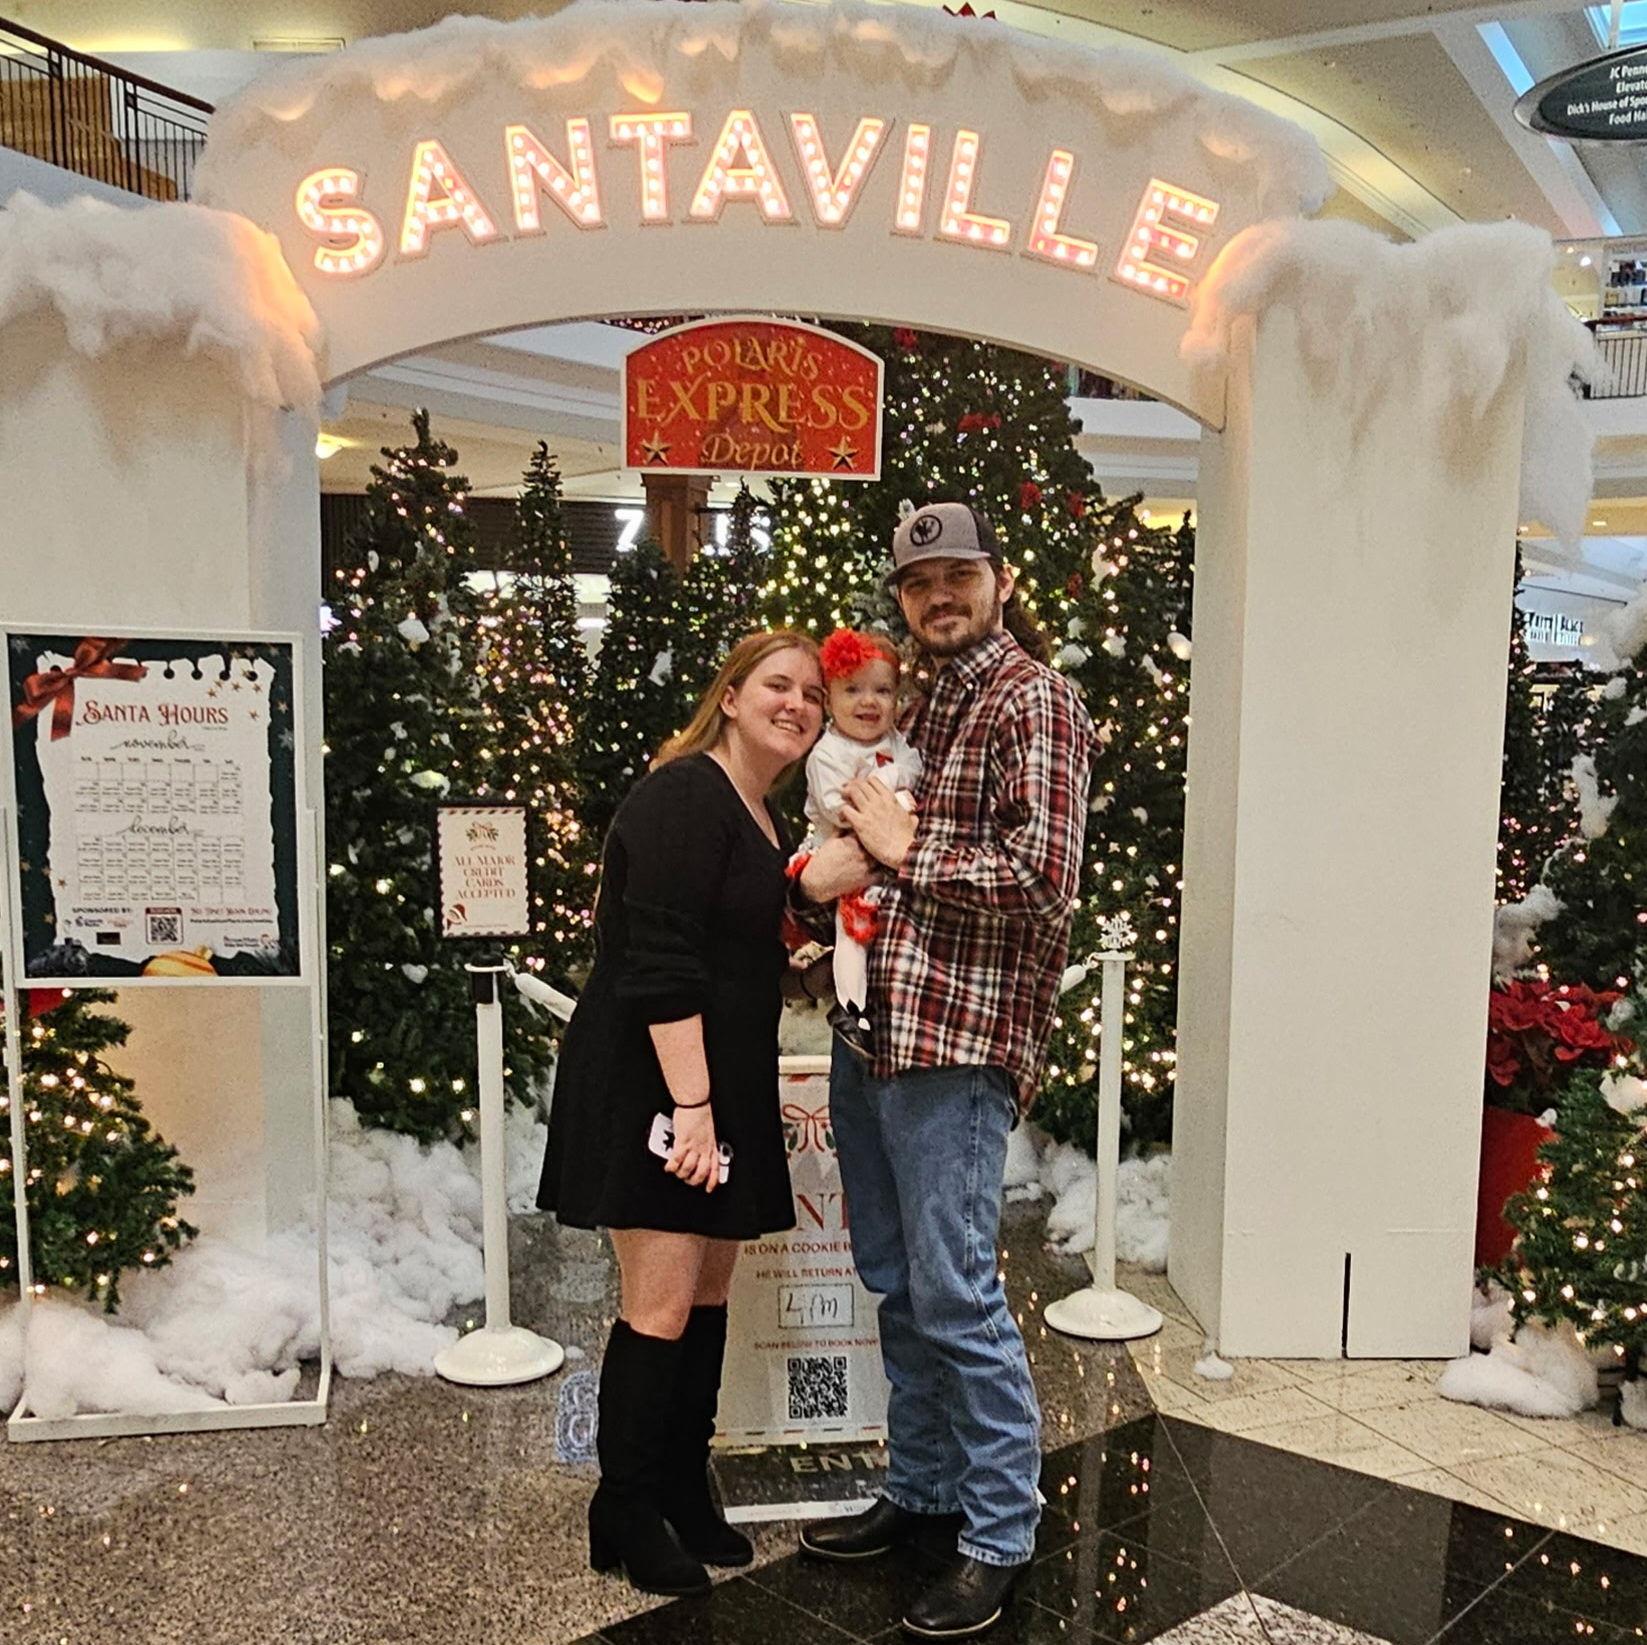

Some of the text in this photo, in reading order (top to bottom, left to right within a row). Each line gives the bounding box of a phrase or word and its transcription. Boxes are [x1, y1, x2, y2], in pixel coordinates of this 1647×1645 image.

[1609, 66, 1621, 80] JC
[1591, 100, 1618, 113] House
[1619, 96, 1629, 108] of
[1609, 112, 1632, 125] Food
[295, 109, 1220, 301] SANTAVILLE
[681, 335, 823, 380] POLARIS
[635, 371, 871, 433] EXPRESS
[701, 432, 803, 471] Depot
[76, 700, 229, 727] SANTA HOURS
[466, 879, 504, 888] CARDS
[759, 1243, 779, 1255] ON
[780, 1243, 789, 1255] A
[791, 1241, 841, 1254] COOKIE
[801, 1266, 843, 1277] RETURN
